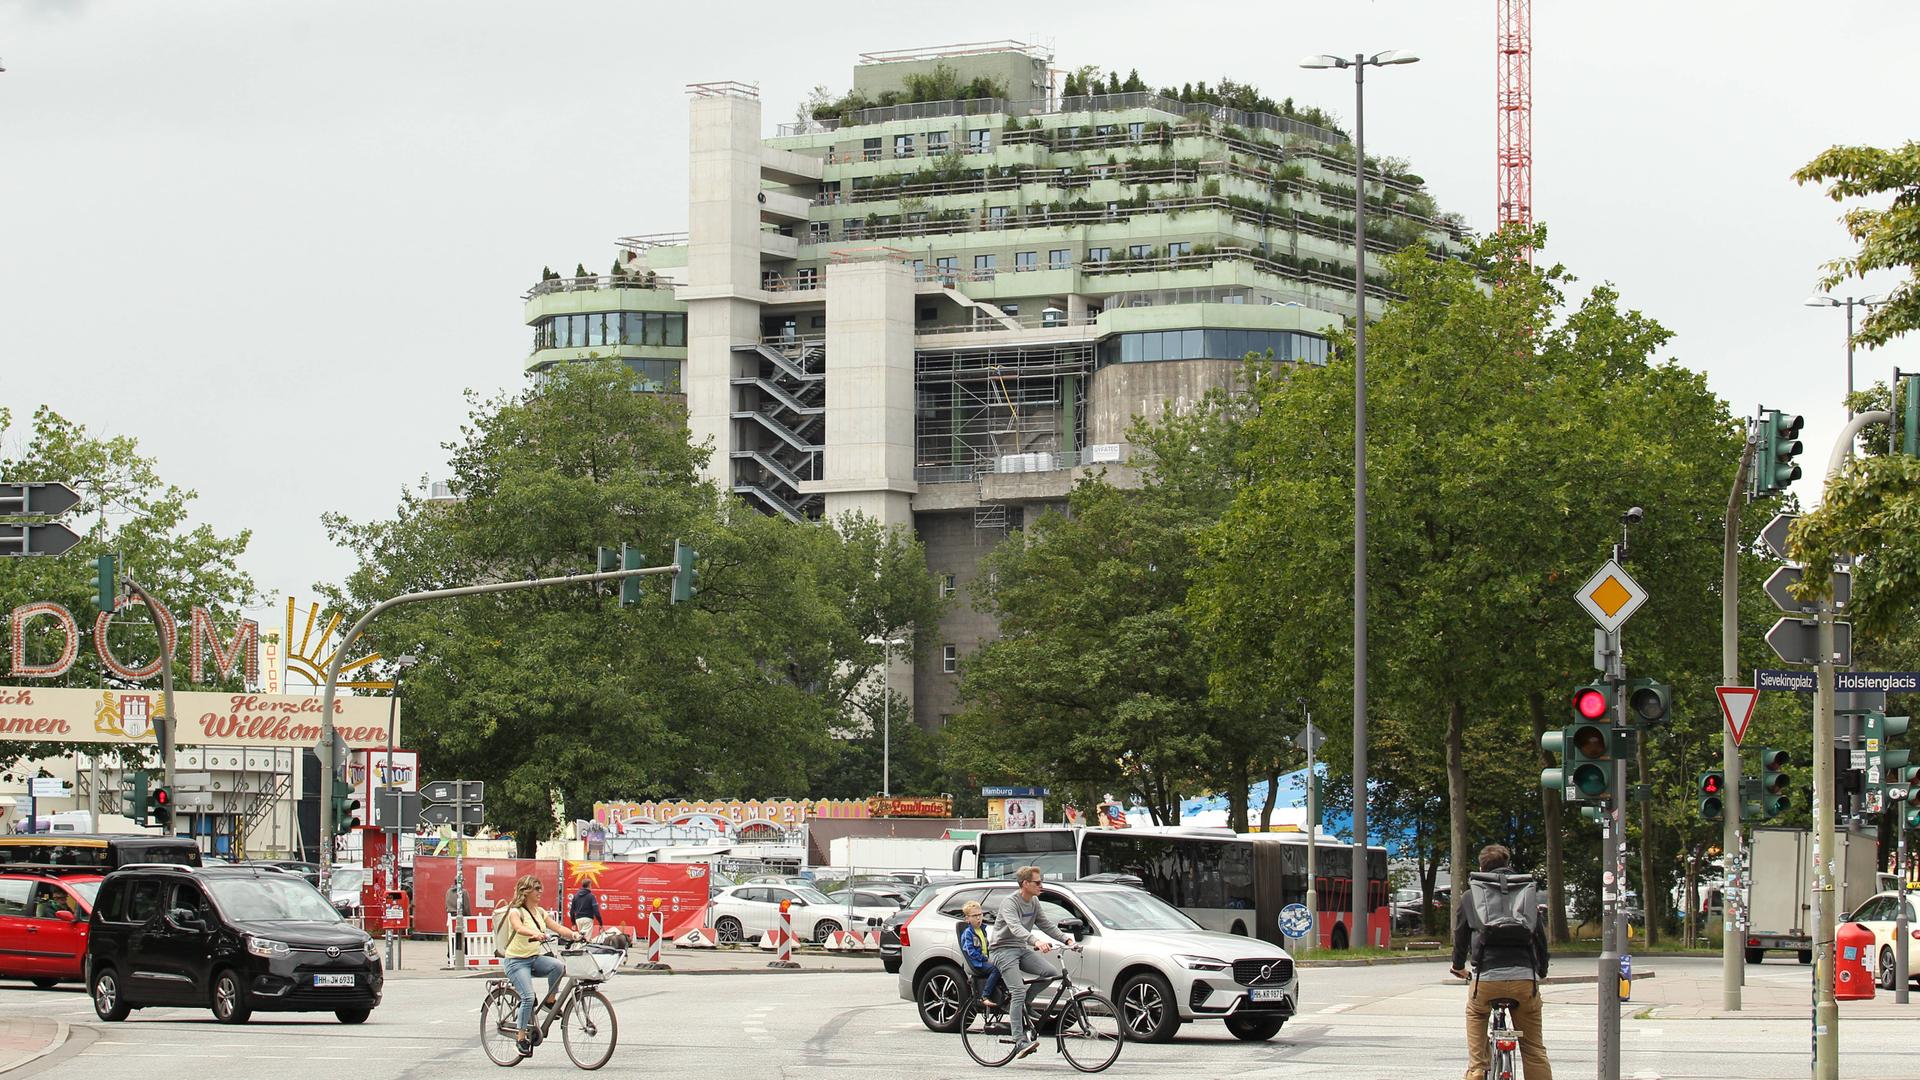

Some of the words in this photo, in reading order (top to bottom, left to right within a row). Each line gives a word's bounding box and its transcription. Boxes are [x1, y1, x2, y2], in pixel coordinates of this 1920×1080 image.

[12, 594, 259, 685] DOM
[1760, 673, 1813, 690] Sievekingplatz
[1838, 675, 1917, 691] Holstenglacis
[0, 690, 34, 706] ich
[231, 695, 343, 714] Herzlich
[318, 976, 327, 984] HH
[339, 976, 354, 984] 6931
